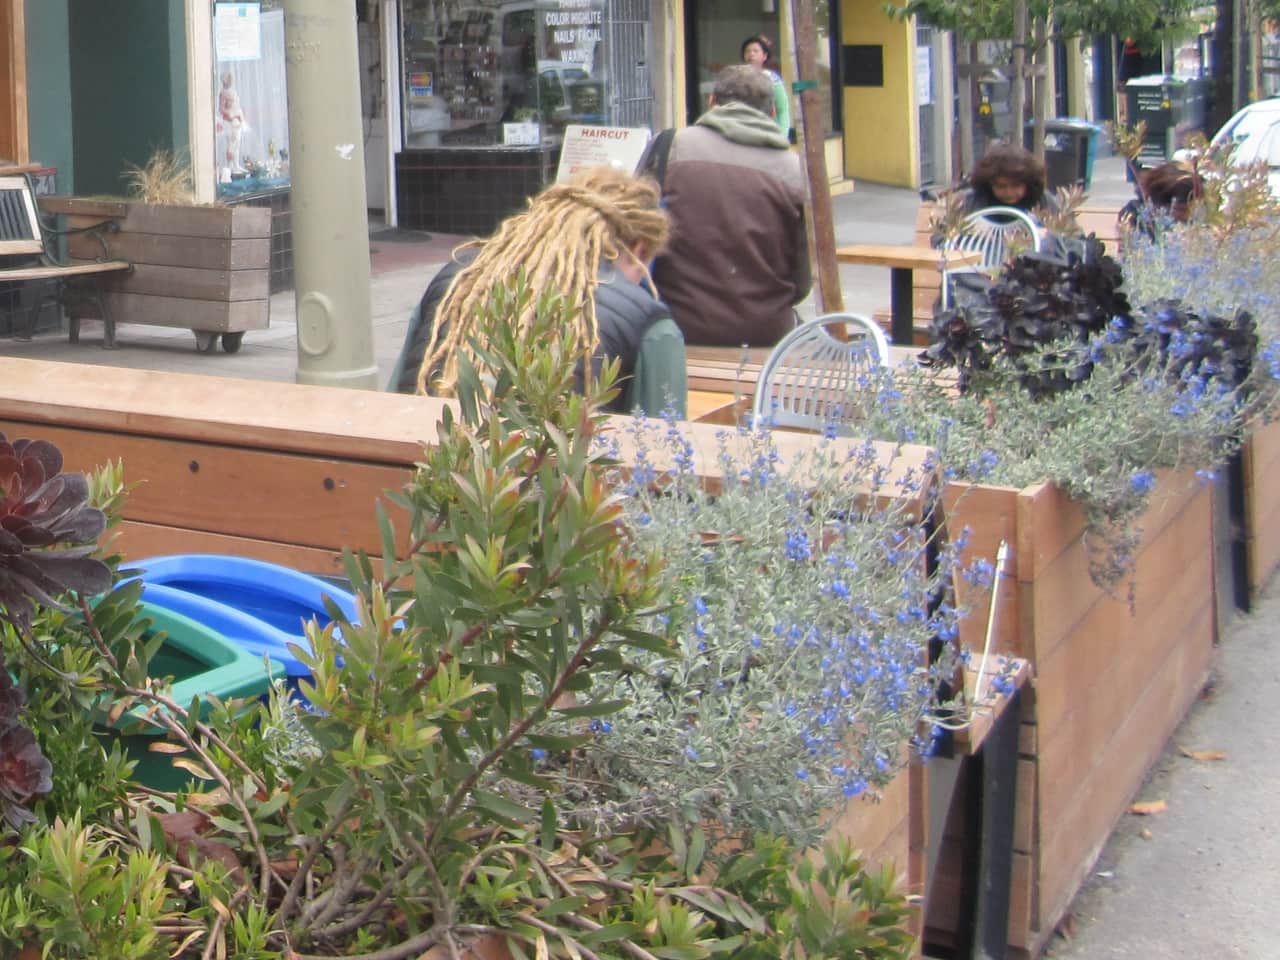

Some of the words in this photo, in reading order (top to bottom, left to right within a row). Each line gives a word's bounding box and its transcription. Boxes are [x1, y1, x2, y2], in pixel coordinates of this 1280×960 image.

[546, 12, 569, 25] COLOR
[554, 31, 574, 43] NAILS
[581, 128, 629, 140] HAIRCUT
